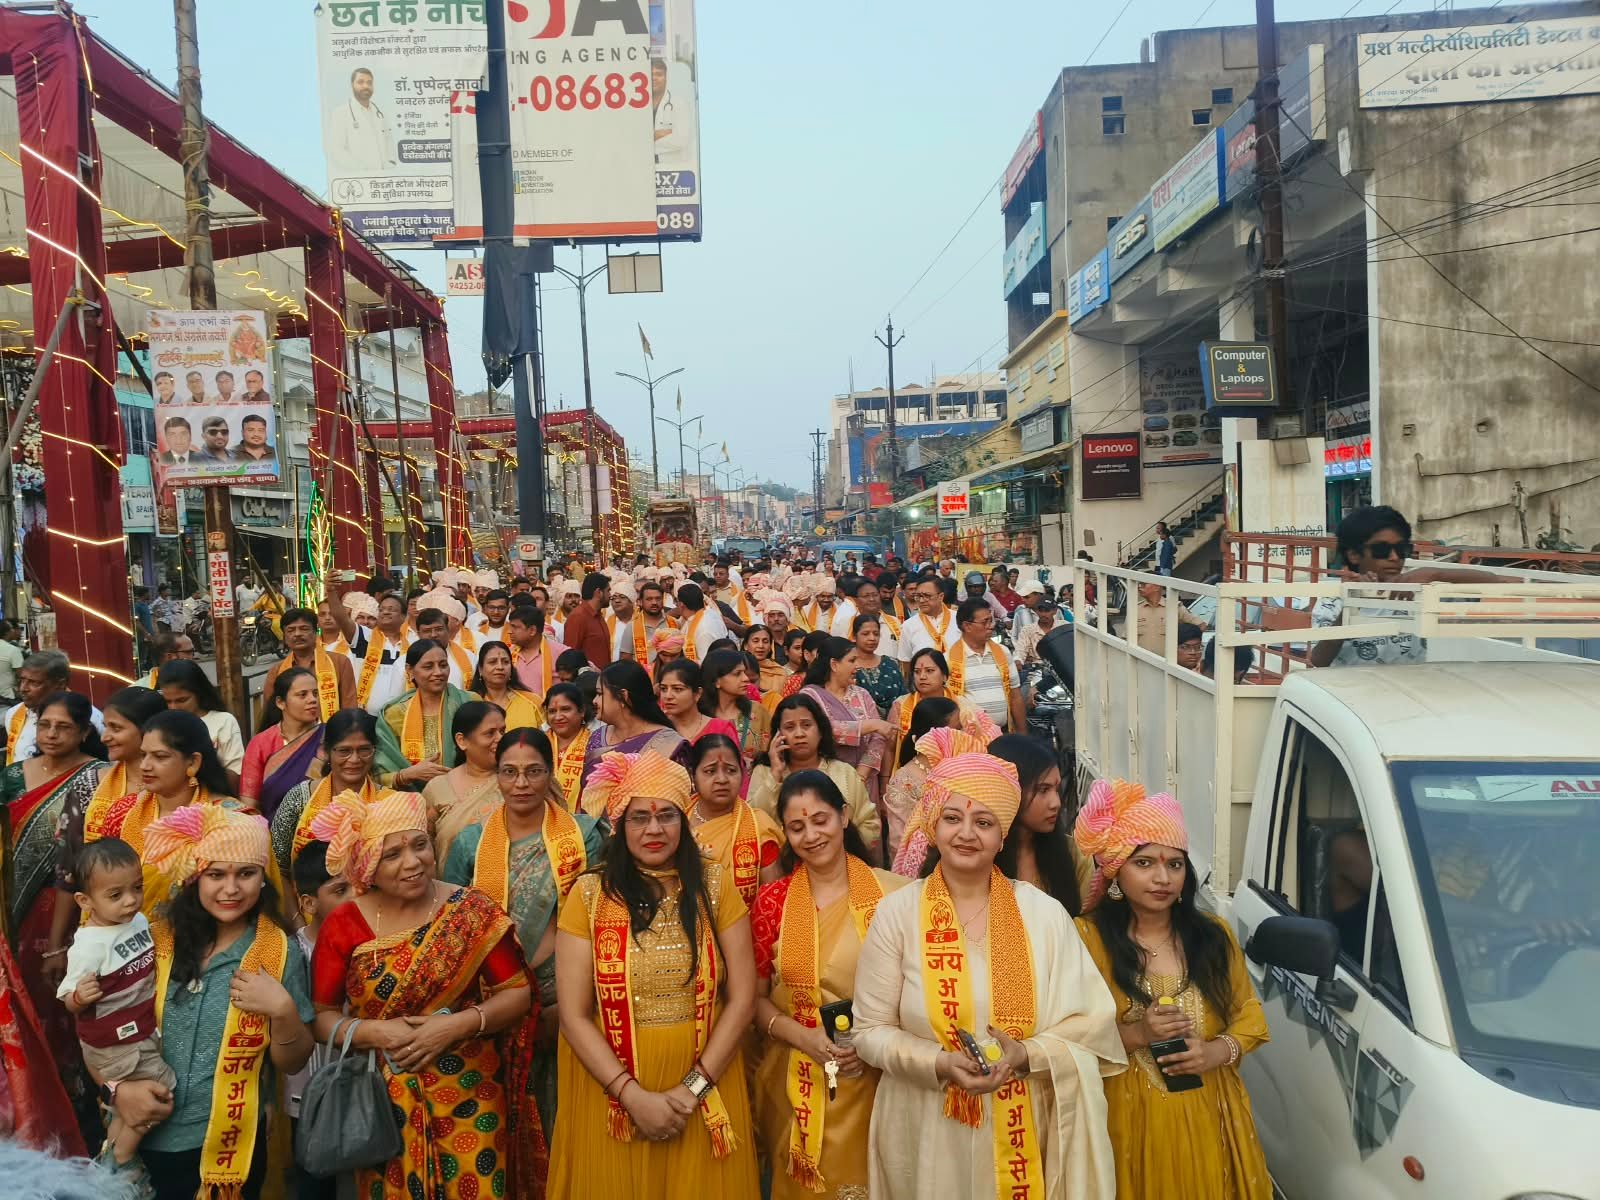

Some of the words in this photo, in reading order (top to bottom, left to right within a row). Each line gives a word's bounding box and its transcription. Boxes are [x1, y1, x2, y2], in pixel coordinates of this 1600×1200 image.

[329, 1, 380, 27] छत
[562, 47, 654, 64] AGENCY
[1364, 42, 1391, 57] यश
[394, 77, 411, 92] डॉ.
[521, 149, 559, 160] MEMBER
[561, 148, 574, 158] OF
[453, 263, 487, 281] AS
[1215, 350, 1267, 363] Computer
[1238, 363, 1247, 374] &
[1221, 374, 1265, 386] Laptops
[1088, 441, 1134, 455] Lenovo
[940, 503, 967, 515] दुकान
[562, 764, 582, 777] जय
[925, 952, 964, 973] जय
[1271, 965, 1350, 1048] STRONG
[223, 1055, 258, 1076] जय
